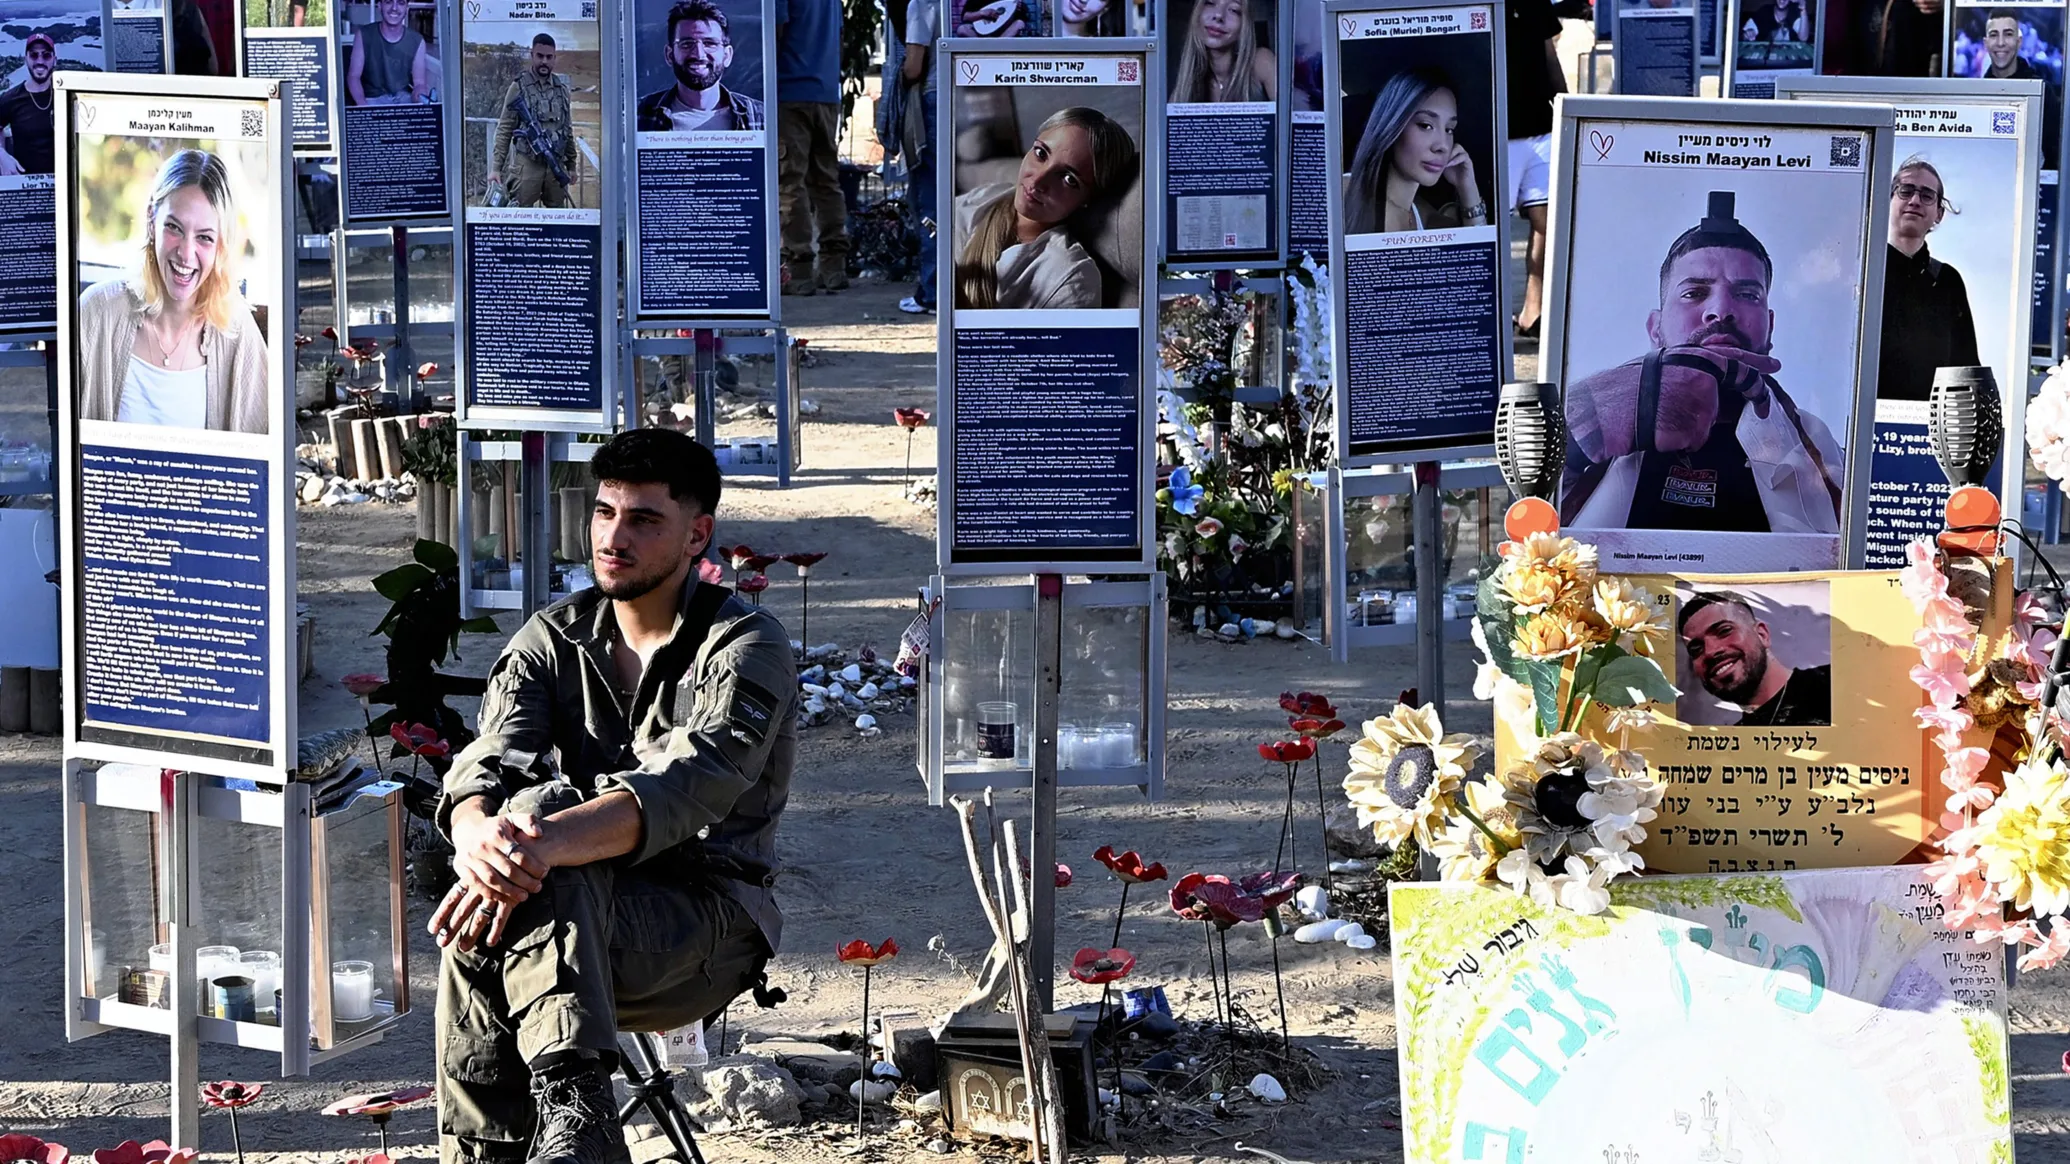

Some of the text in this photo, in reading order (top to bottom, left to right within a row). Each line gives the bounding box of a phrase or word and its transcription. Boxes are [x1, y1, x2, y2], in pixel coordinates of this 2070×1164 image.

[1402, 15, 1429, 24] מוריאל
[1431, 14, 1453, 22] סופיה
[1365, 24, 1460, 37] Sofia (Muriel) Bongart
[1011, 62, 1084, 72] קארין שוורצמן
[995, 74, 1098, 83] Karin Shwarcman
[148, 108, 192, 119] מעין קליכמן
[1930, 110, 1957, 119] עמית
[129, 121, 214, 133] Maayan Kalihman
[1912, 123, 1934, 132] Ben
[1938, 124, 1972, 133] Avida
[671, 136, 692, 144] nothing
[725, 135, 740, 144] being
[1678, 135, 1771, 148] לוי ניסים מעיין
[1644, 150, 1811, 169] Nissim Maayan Levi
[566, 211, 574, 220] do
[1382, 233, 1456, 246] "FUN FOREVER"
[1883, 432, 1897, 441] 19
[1879, 445, 1904, 456] Lizy,
[1871, 482, 1909, 491] ctober
[1912, 483, 1922, 493] 7,
[1869, 494, 1899, 503] ature
[1903, 496, 1933, 506] party
[1876, 506, 1916, 516] sounds
[1920, 508, 1932, 517] of
[1891, 519, 1922, 528] When
[1926, 520, 1940, 530] he
[1867, 531, 1894, 539] went
[1636, 553, 1663, 561] Maayan
[1679, 553, 1704, 562] [43899]
[1866, 555, 1904, 565] tacked
[1654, 595, 1670, 606] .23
[1687, 731, 1817, 751] לעילוי נשמת
[1658, 765, 1712, 784] שמחה
[1722, 766, 1768, 784] מרים
[1778, 766, 1797, 787] בן
[1807, 766, 1849, 787] מעין
[1860, 766, 1909, 785] ניסים
[1660, 796, 1690, 816] עוו
[1706, 797, 1740, 813] בני
[1749, 829, 1807, 846] תשרי
